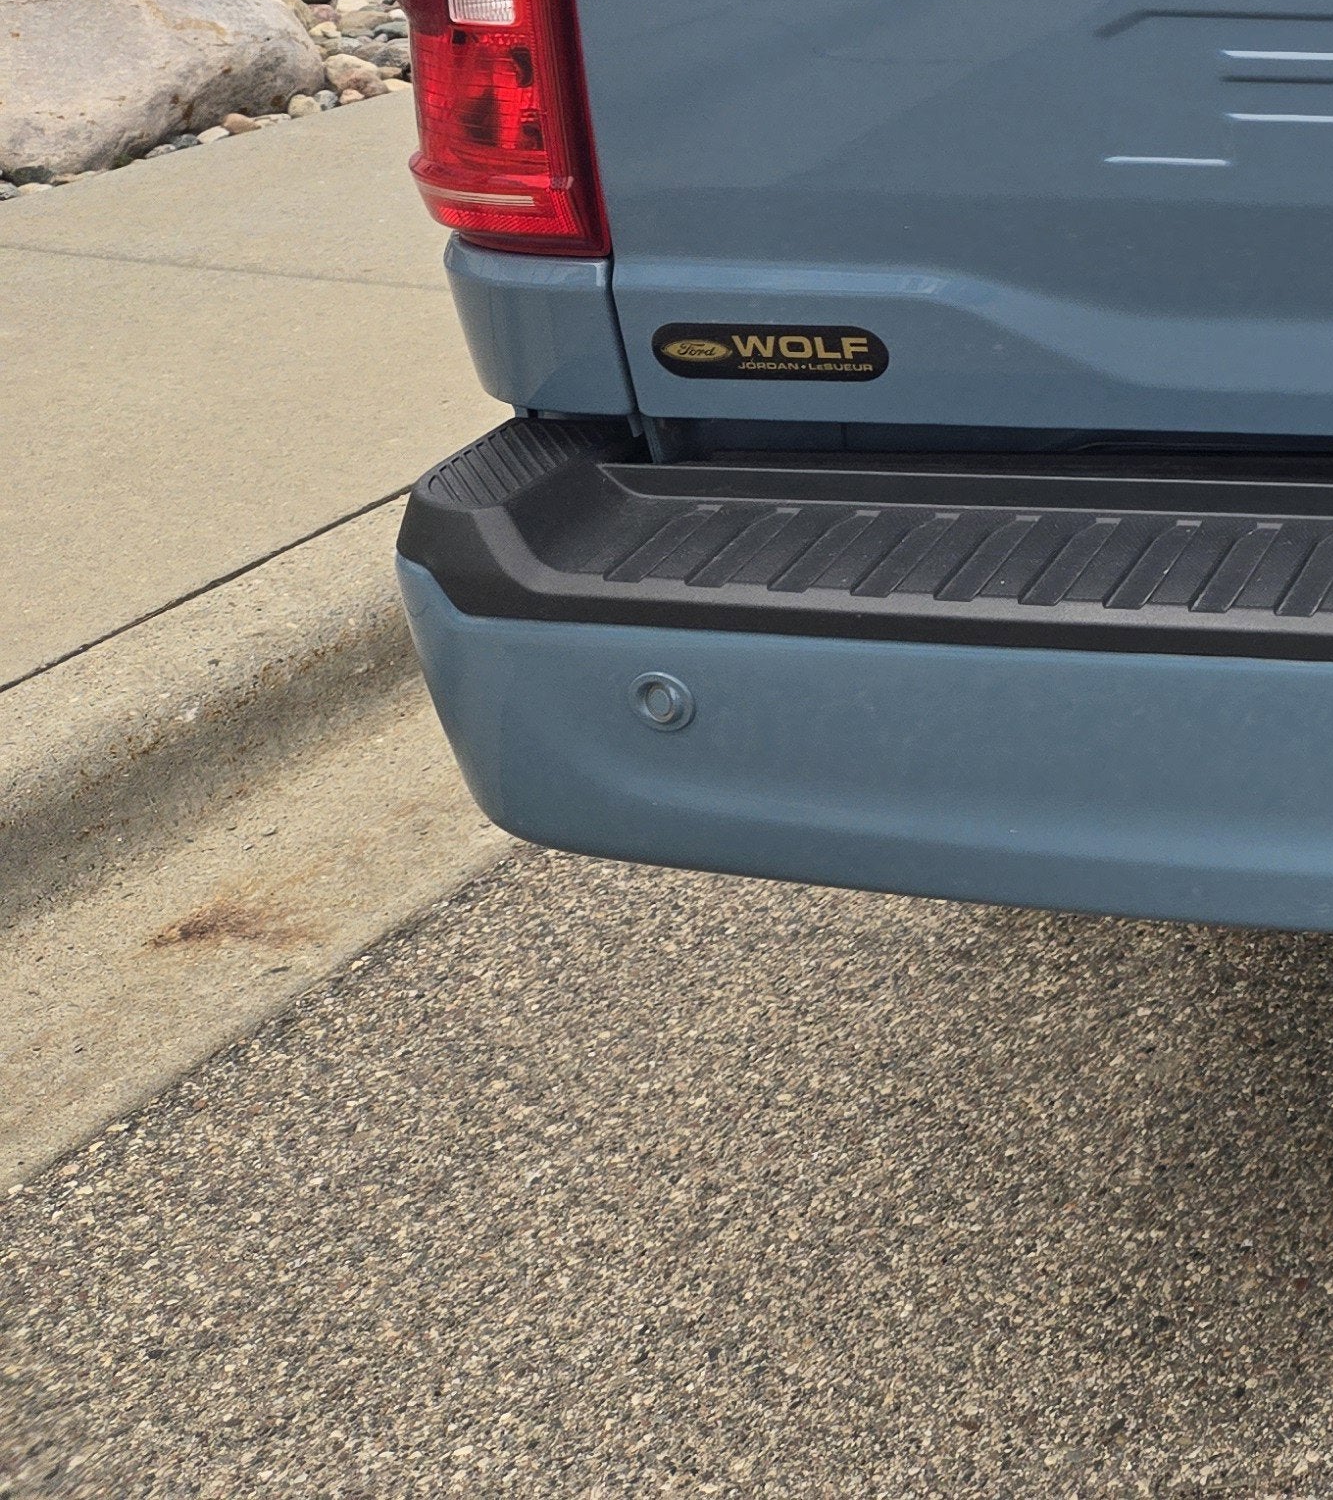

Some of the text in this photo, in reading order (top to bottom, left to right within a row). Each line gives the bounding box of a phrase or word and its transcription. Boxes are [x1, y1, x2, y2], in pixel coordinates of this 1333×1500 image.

[676, 342, 716, 357] Ford
[731, 335, 869, 360] WOLF
[737, 362, 799, 371] JORDAN
